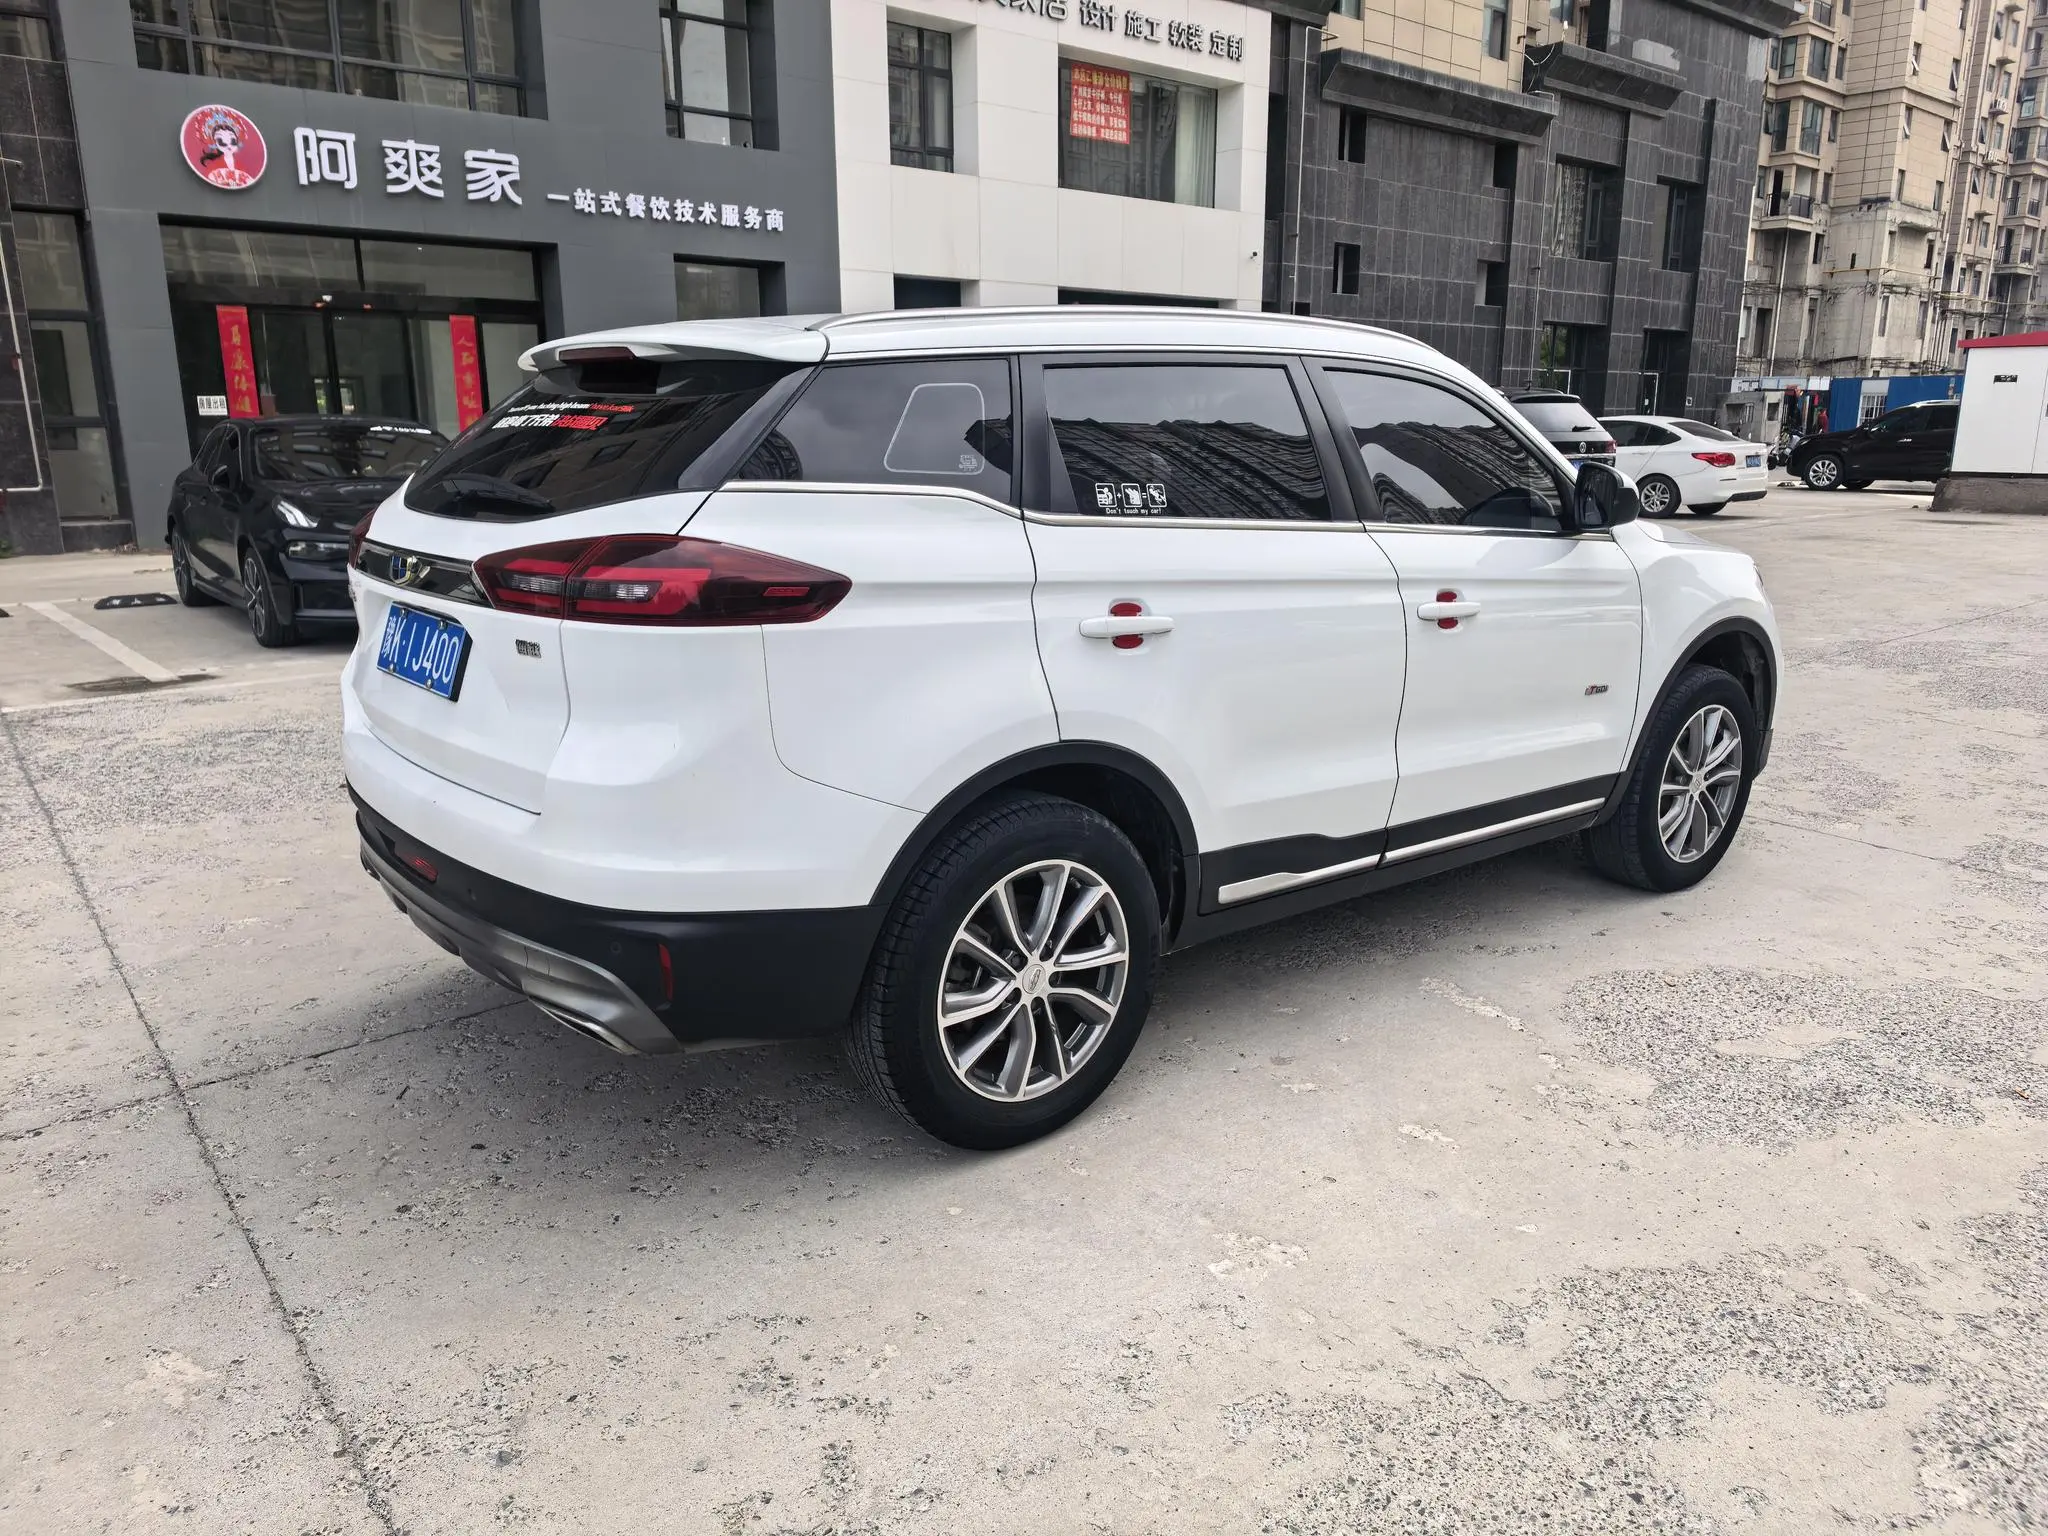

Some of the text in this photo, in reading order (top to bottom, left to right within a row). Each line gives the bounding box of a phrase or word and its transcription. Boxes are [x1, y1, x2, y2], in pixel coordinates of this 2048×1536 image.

[1080, 0, 1119, 31] 设计
[1125, 9, 1163, 43] 施工
[1168, 20, 1204, 52] 软装
[1210, 30, 1244, 60] 定制
[294, 127, 522, 205] 阿爽家
[547, 188, 784, 232] 一站式餐饮技术服务商
